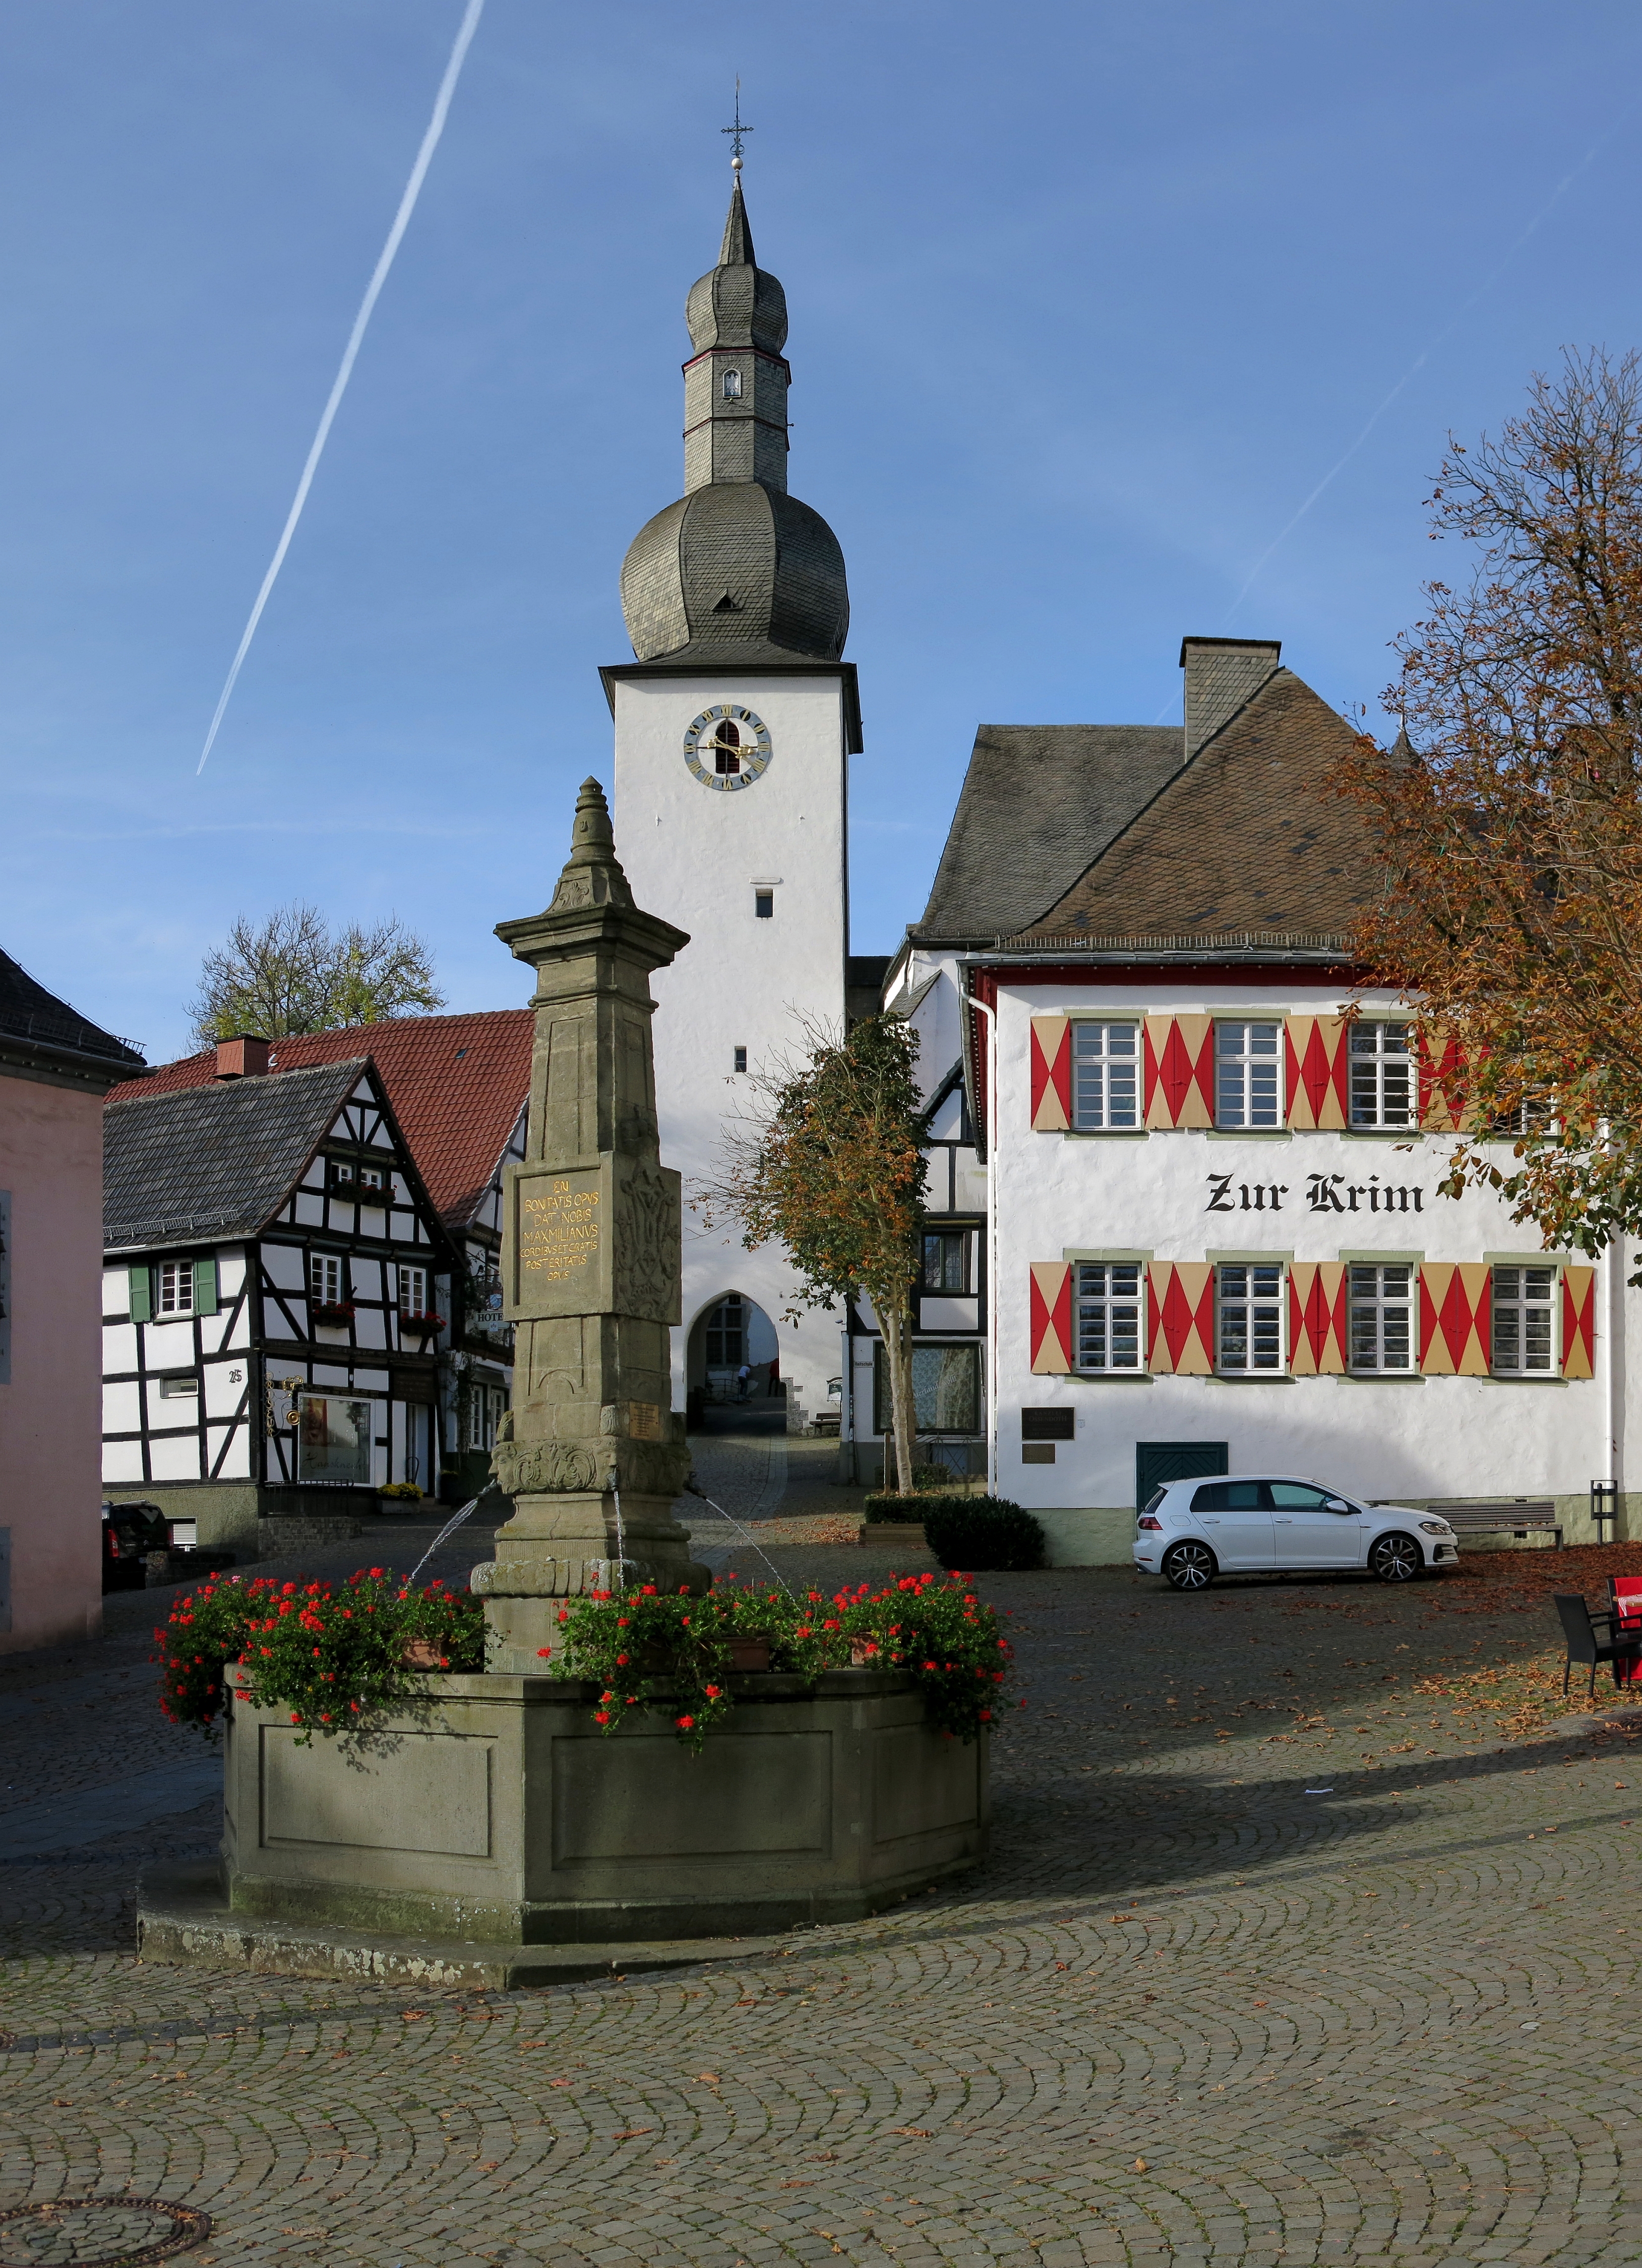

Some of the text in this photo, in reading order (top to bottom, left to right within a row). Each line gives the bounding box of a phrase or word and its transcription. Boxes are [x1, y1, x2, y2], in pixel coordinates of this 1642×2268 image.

[554, 1180, 569, 1193] EN
[1204, 1173, 1424, 1213] Zur Krim
[534, 1208, 591, 1227] DAT NOBIS
[477, 1313, 503, 1321] HOTE
